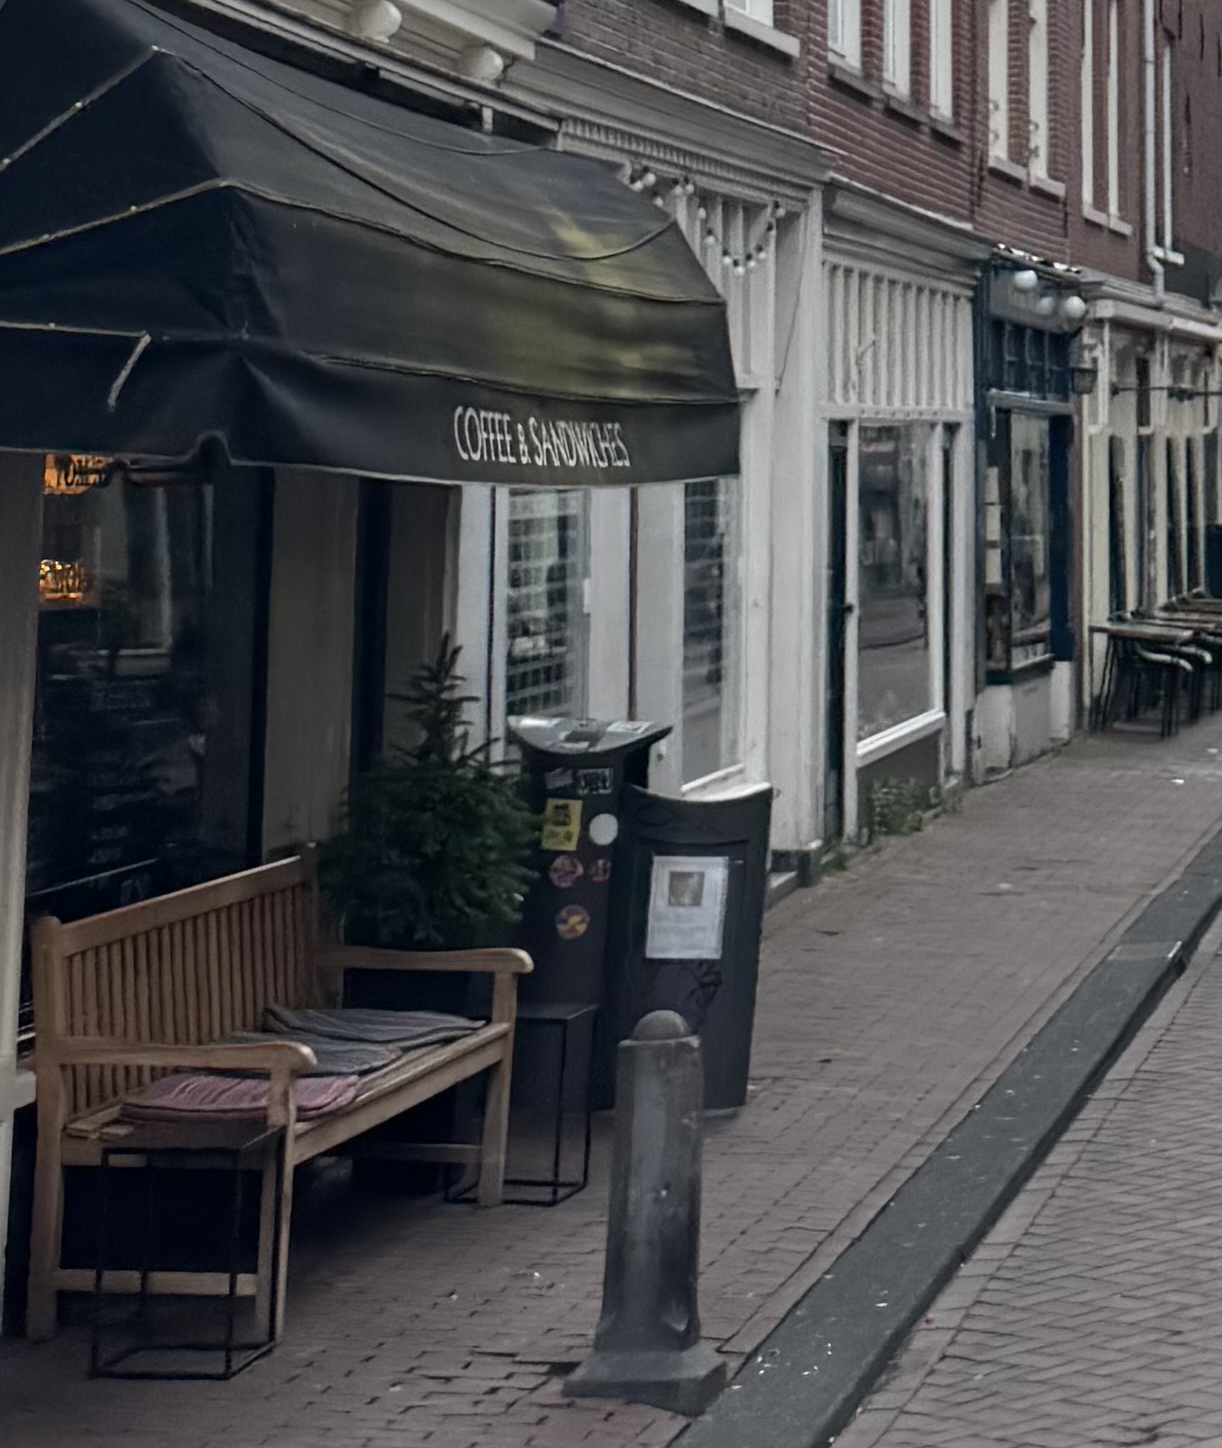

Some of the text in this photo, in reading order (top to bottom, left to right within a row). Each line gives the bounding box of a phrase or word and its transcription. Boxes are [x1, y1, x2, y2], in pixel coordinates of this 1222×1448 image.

[454, 406, 631, 468] COFFEE & SANDWICHES
